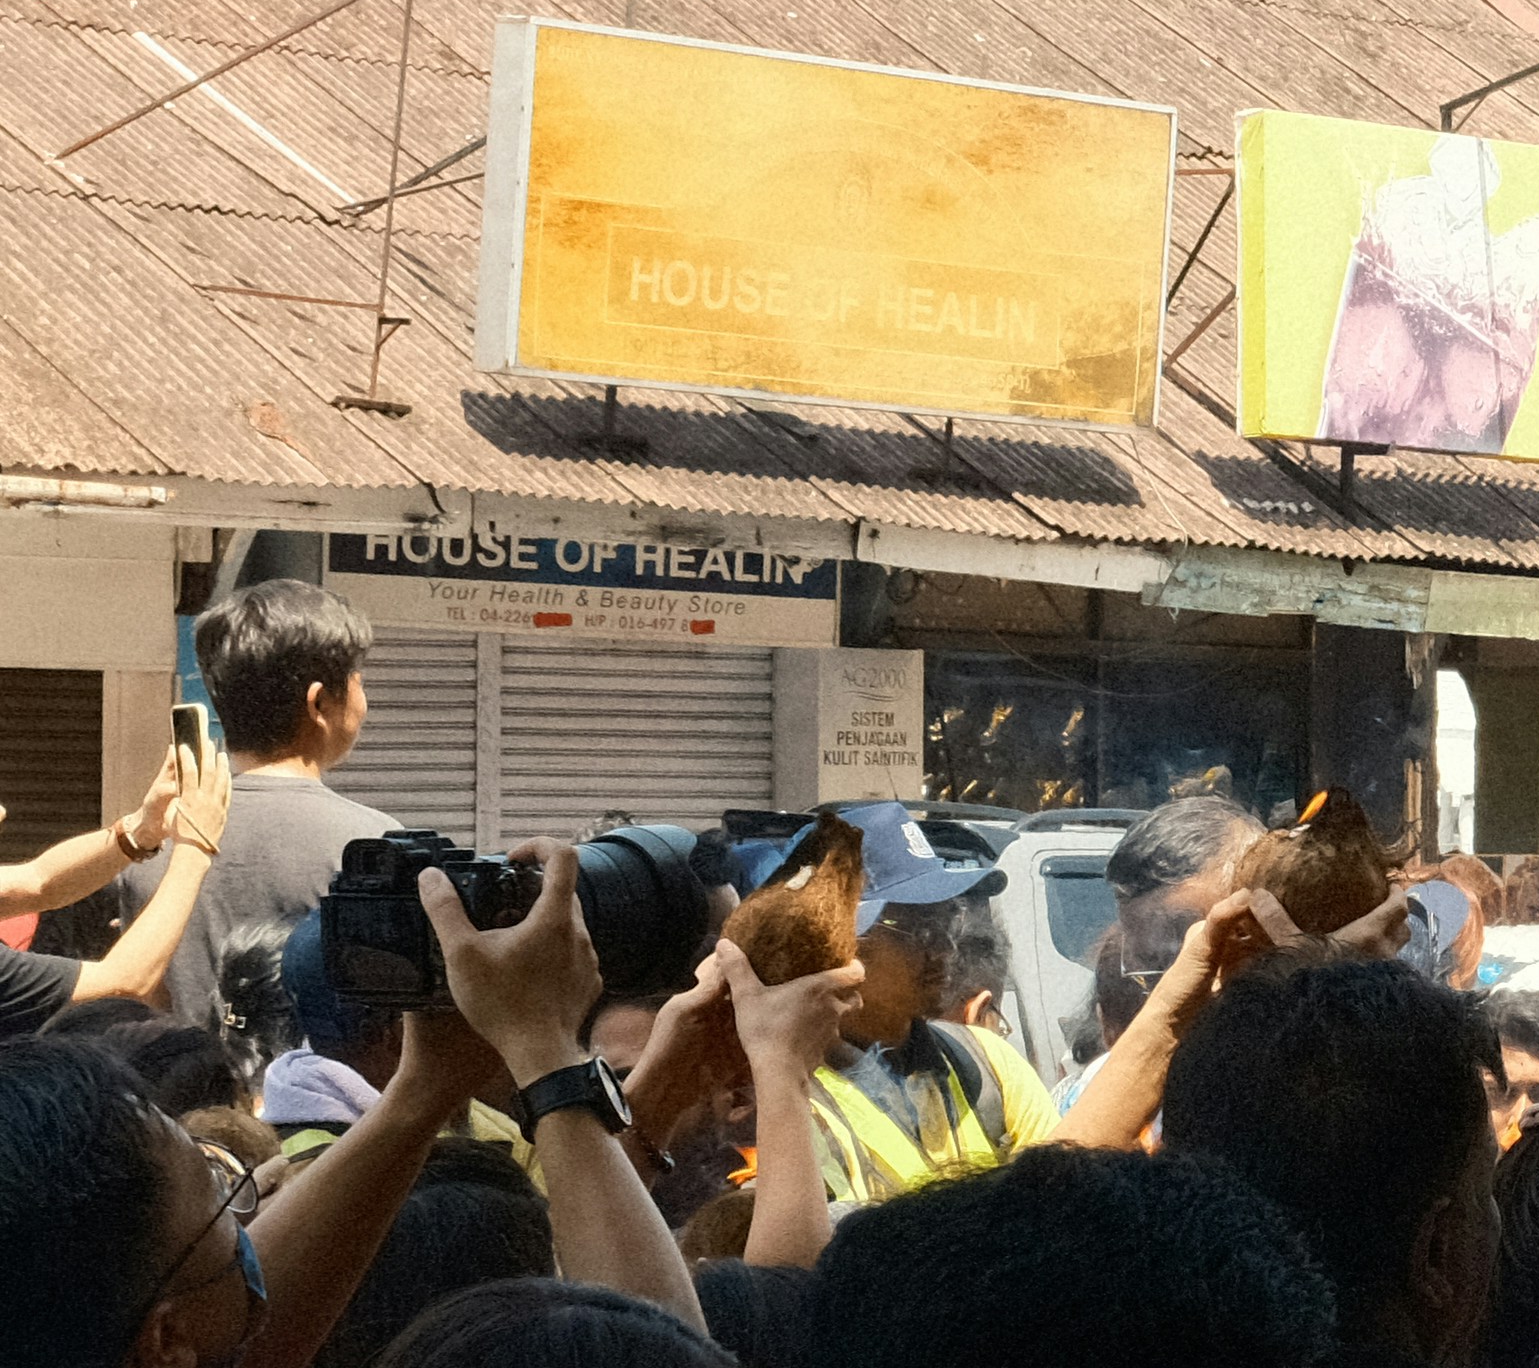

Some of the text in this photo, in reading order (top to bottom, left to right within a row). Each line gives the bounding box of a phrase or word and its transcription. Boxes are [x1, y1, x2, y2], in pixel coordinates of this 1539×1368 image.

[628, 256, 791, 318] HOUSE
[804, 277, 860, 325] OF
[365, 533, 539, 570] HOUSE
[427, 582, 747, 616] Your Health & Beauty Store
[851, 712, 895, 727] SISTEM
[837, 731, 907, 747] PENJAGAAN
[823, 750, 918, 767] KULIT SAINTIFIK
